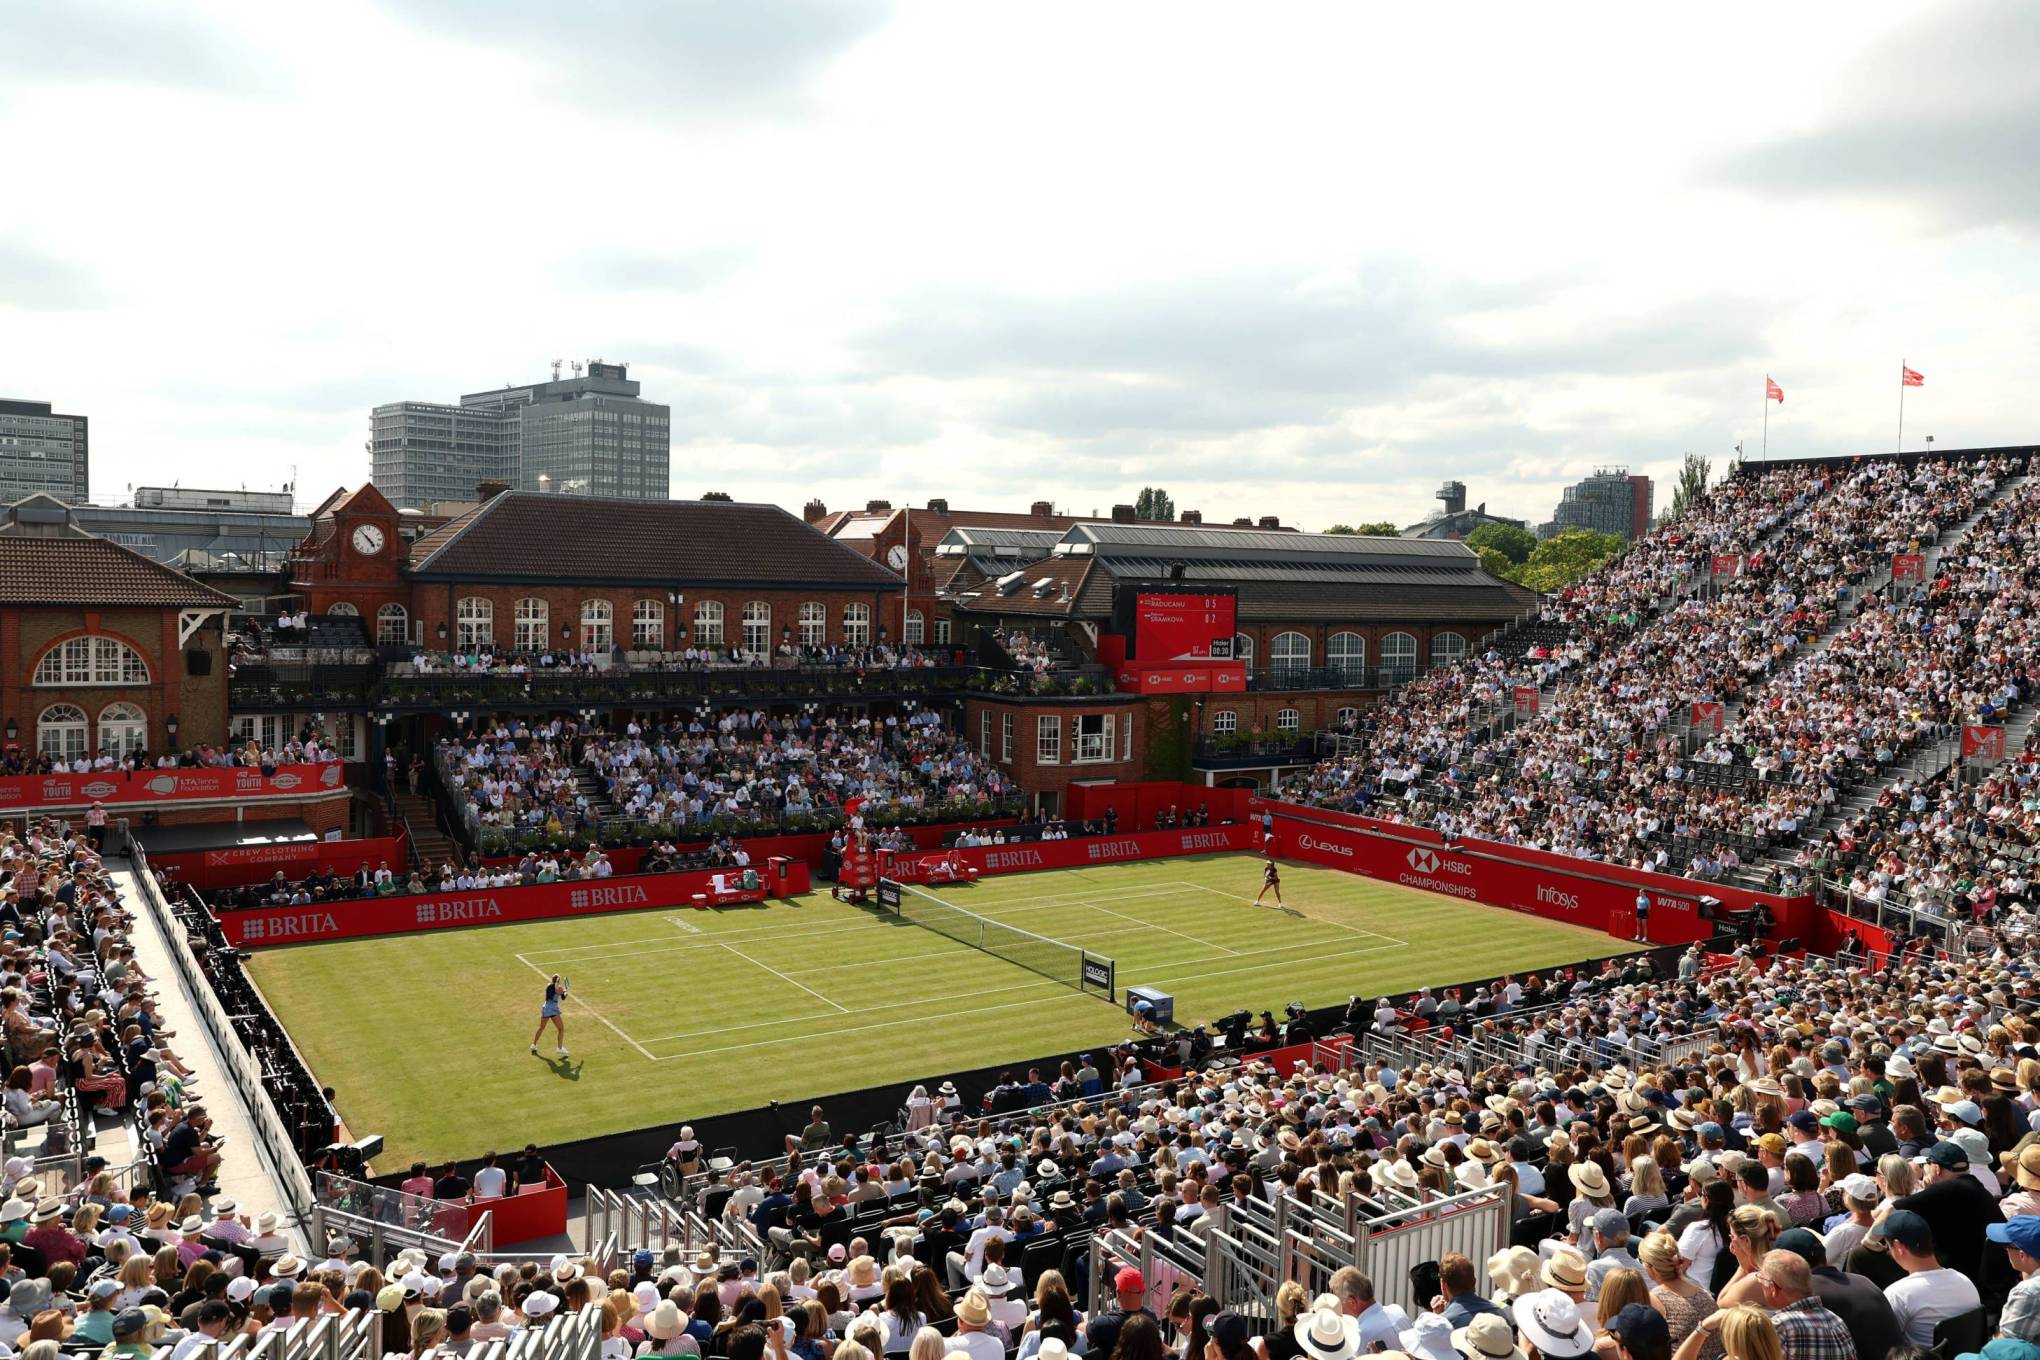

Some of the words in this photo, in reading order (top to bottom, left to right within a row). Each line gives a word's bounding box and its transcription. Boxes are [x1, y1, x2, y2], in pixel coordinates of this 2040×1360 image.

[236, 777, 262, 789] YOUTH
[42, 786, 72, 798] YOUTH
[1192, 832, 1230, 849] BRITA
[1313, 840, 1353, 856] LEXUS
[232, 849, 261, 858] CREW
[265, 845, 315, 855] CLOTHING
[1101, 840, 1141, 858] BRITA
[250, 854, 298, 863] COMPANY
[1000, 850, 1043, 867] BRITA
[1442, 860, 1472, 876] HSBC
[1400, 873, 1477, 899] CHAMPIONSHIPS
[591, 885, 649, 906] BRITA
[1537, 884, 1579, 910] Infosys
[438, 898, 503, 920] BRITA
[1657, 897, 1678, 909] WTA
[1677, 902, 1690, 912] 500
[267, 912, 339, 937] BRITA
[1718, 923, 1738, 934] Haier
